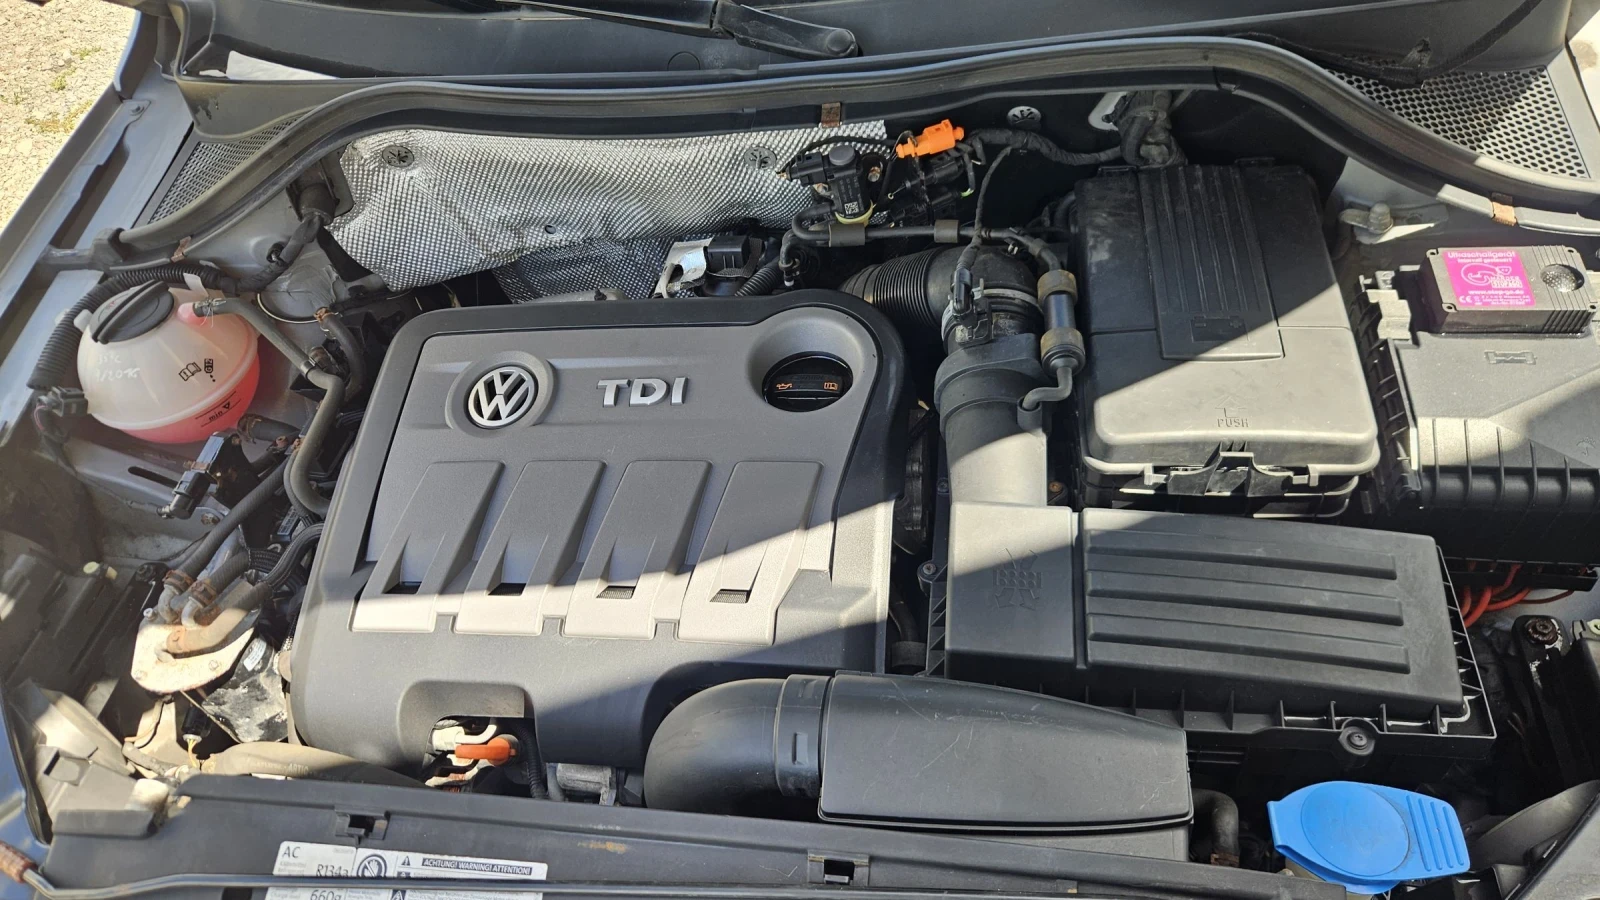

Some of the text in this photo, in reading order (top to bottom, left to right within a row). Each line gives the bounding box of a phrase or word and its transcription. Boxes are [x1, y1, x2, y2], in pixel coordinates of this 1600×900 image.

[597, 376, 688, 407] TDI
[208, 410, 223, 421] min
[1217, 418, 1249, 428] PUSH
[281, 845, 301, 859] AC
[315, 863, 349, 876] R134a
[423, 858, 531, 875] ACHTUNG! WARNING! ATTENTION!
